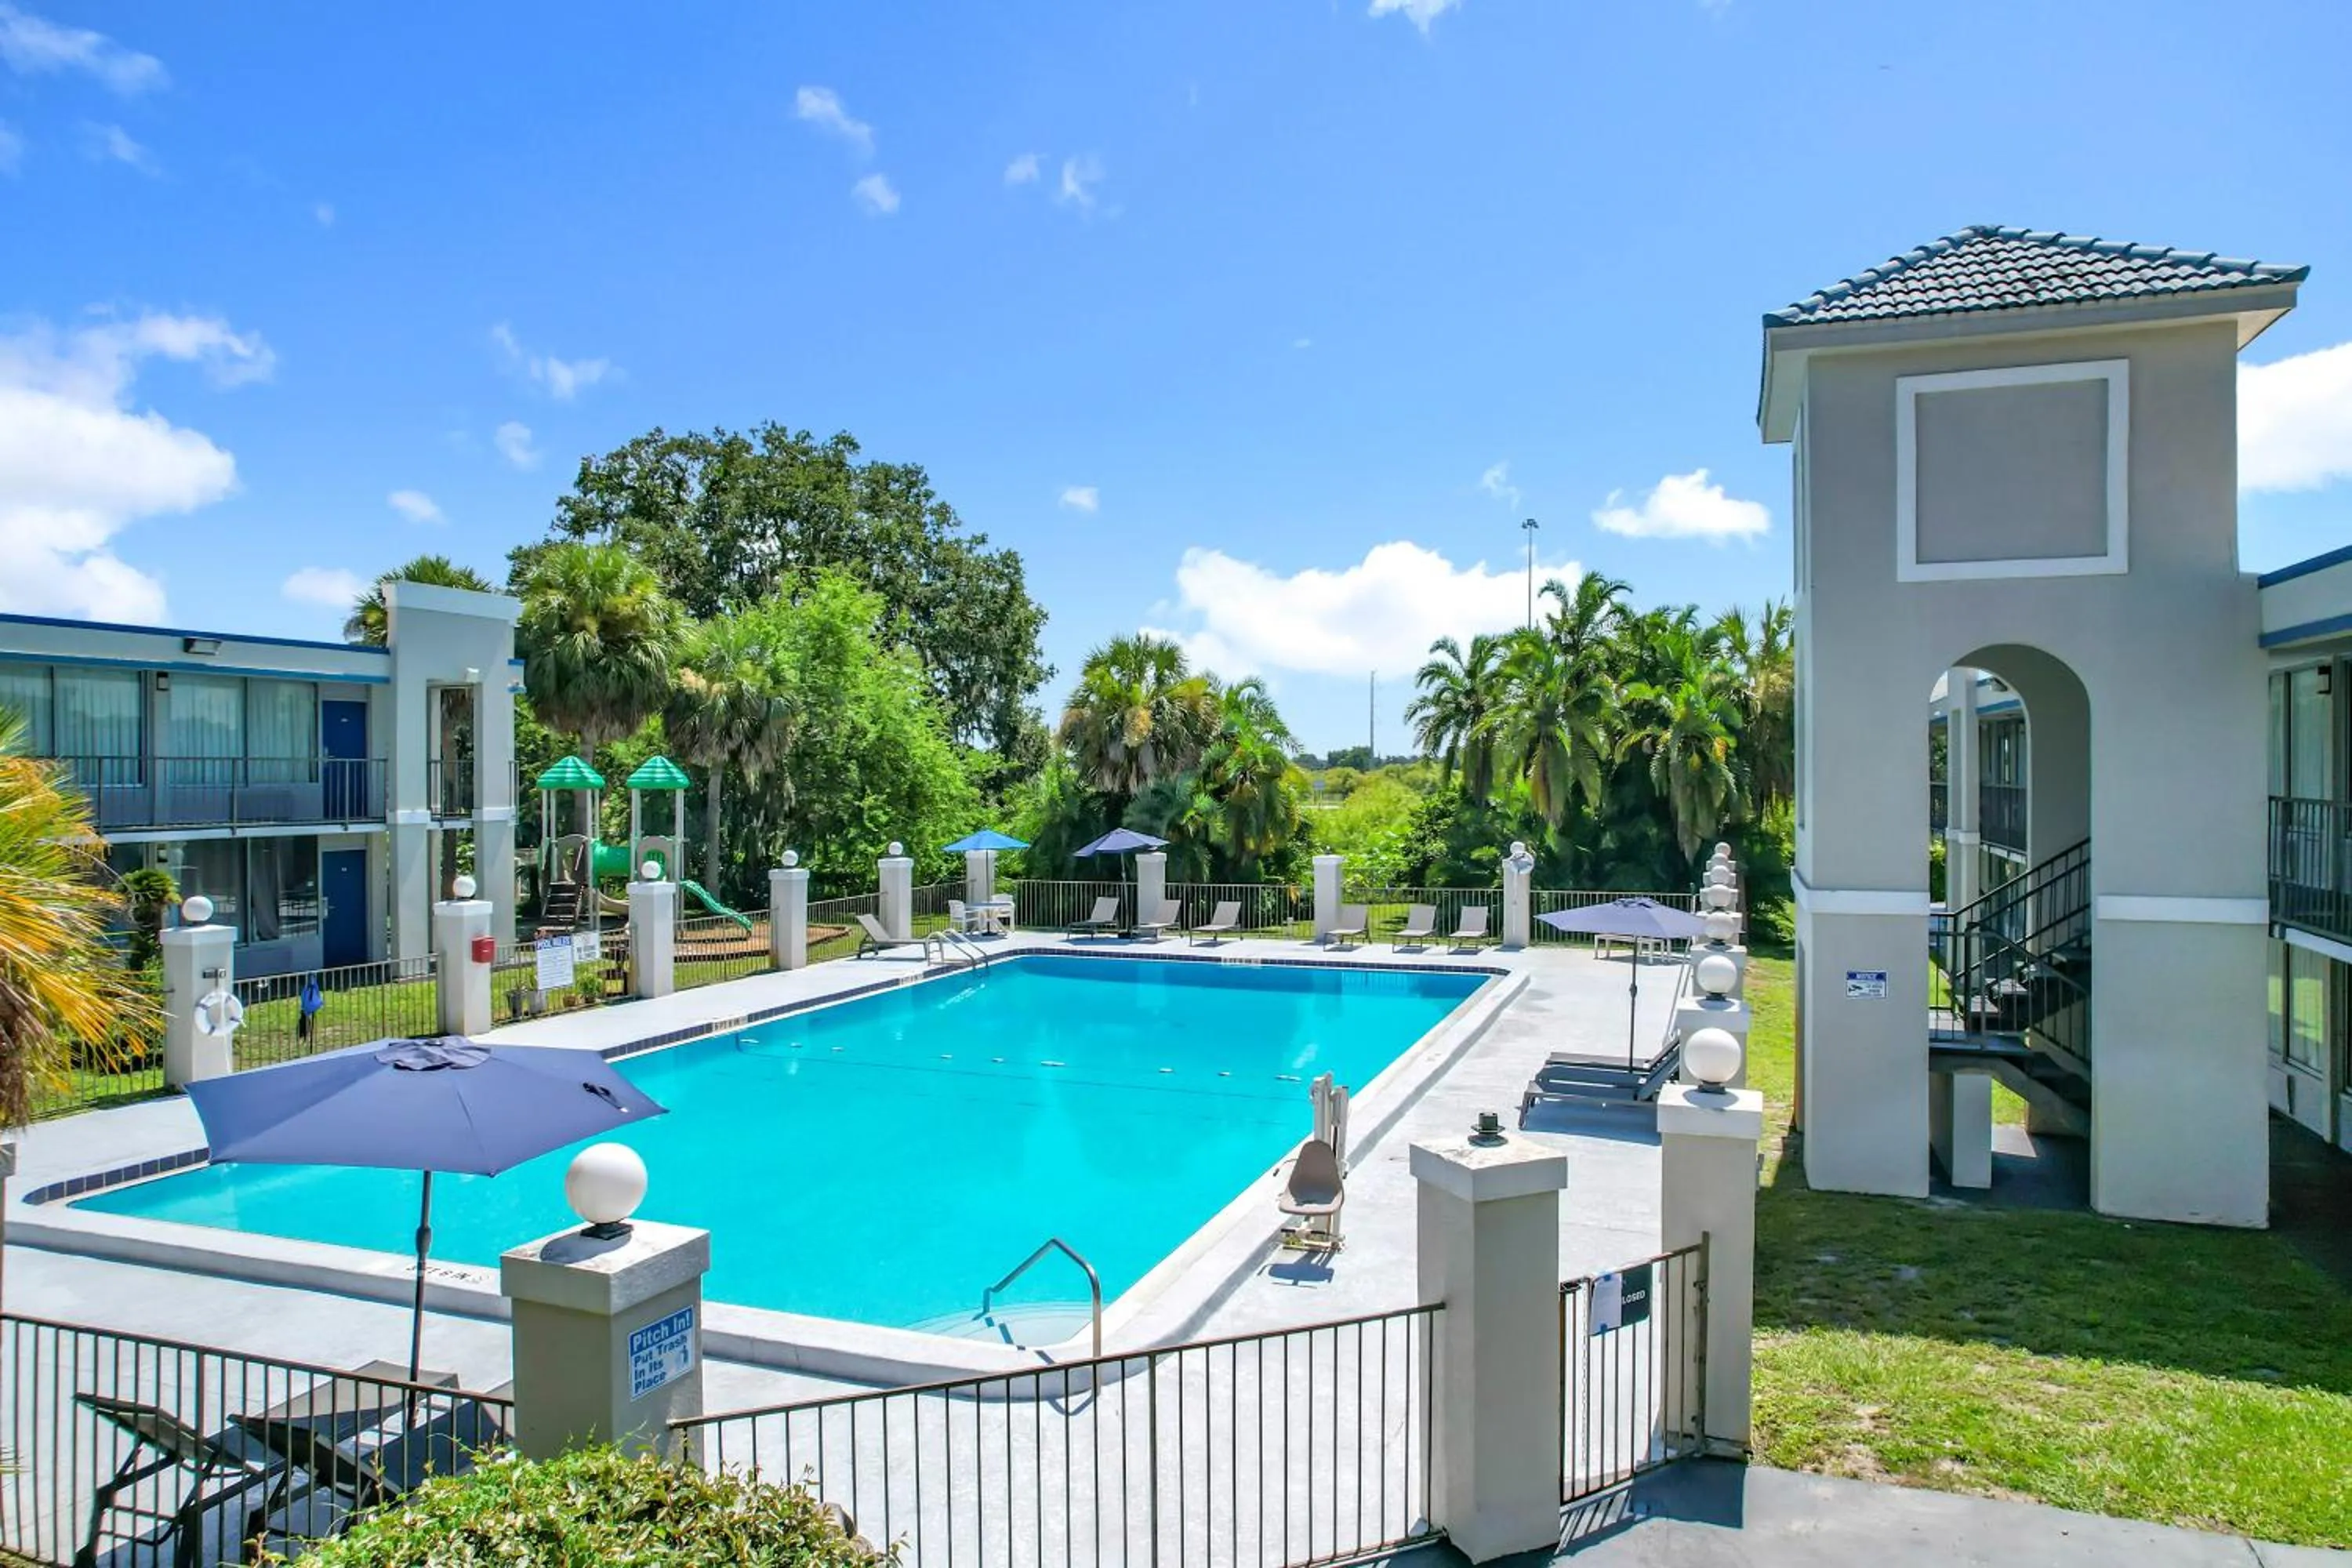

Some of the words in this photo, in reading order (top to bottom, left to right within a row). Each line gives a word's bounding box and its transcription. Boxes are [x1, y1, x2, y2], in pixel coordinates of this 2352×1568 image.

[1622, 1290, 1646, 1305] LOSED
[633, 1323, 669, 1352] Pitch
[673, 1312, 691, 1330] In!
[634, 1350, 652, 1367] Put
[656, 1335, 688, 1356] Trash
[634, 1367, 644, 1381] In
[634, 1371, 666, 1394] Place
